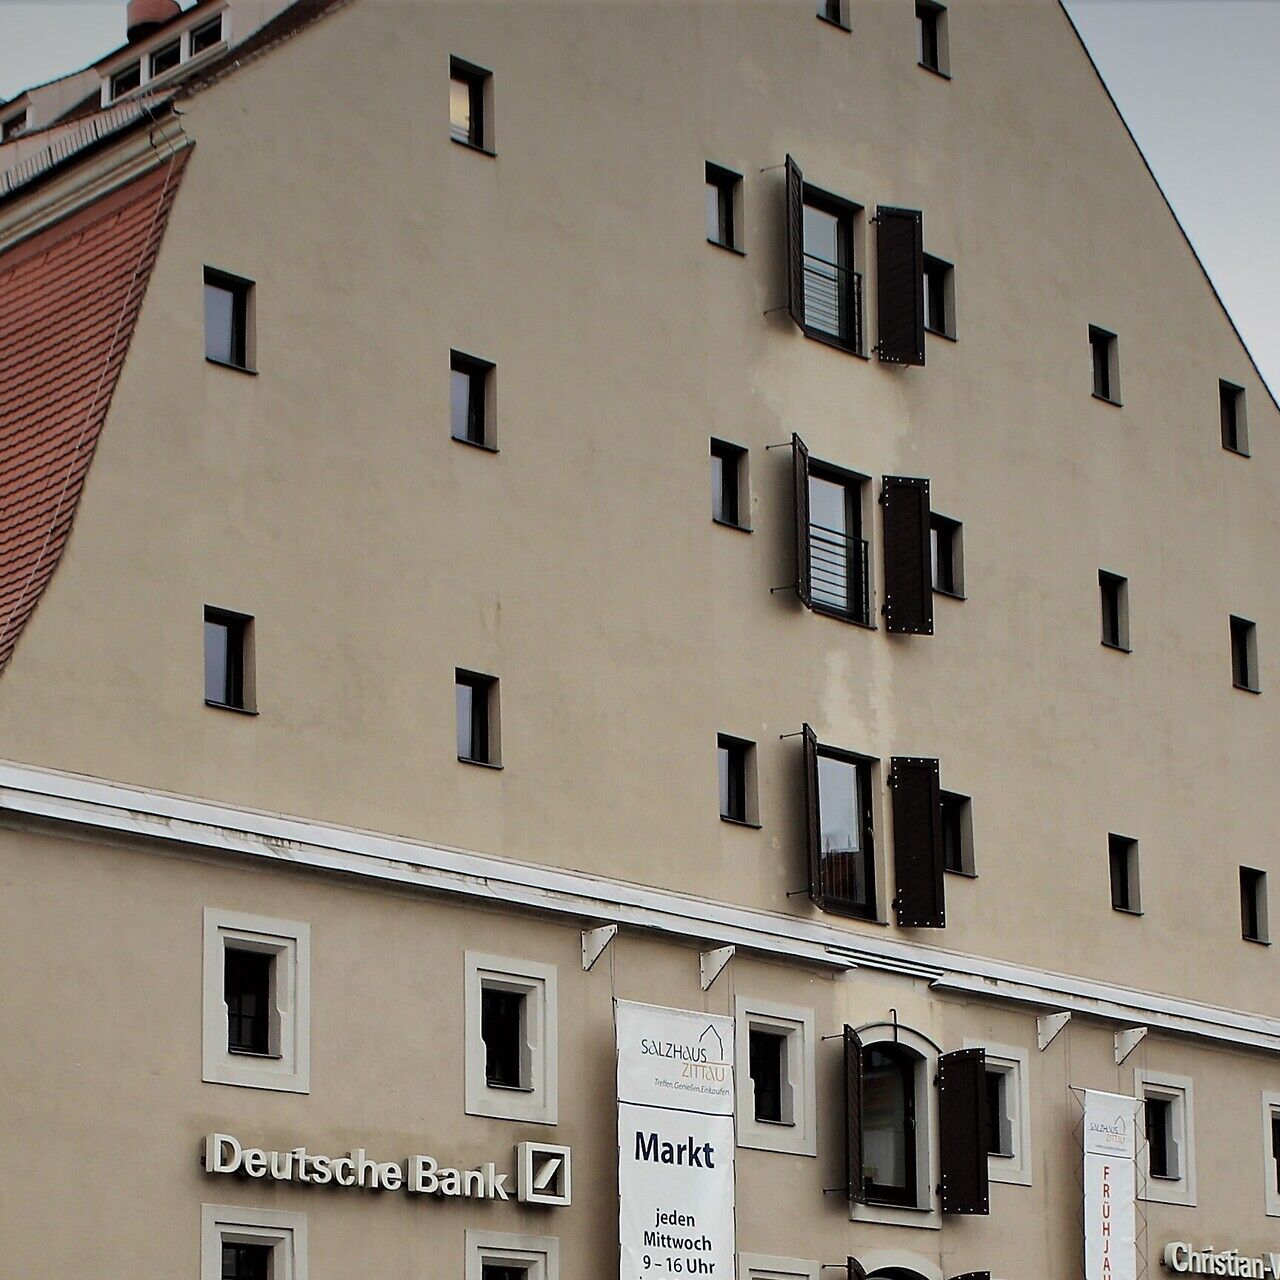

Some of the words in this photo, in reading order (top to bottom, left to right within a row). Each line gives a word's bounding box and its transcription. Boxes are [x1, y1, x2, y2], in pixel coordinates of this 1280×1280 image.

[640, 1038, 708, 1064] SALZHAUS
[682, 1063, 725, 1082] ZITTAU
[634, 1131, 715, 1169] Markt
[206, 1133, 403, 1191] Deutsche
[407, 1155, 510, 1201] Bank
[655, 1207, 696, 1228] jeden
[643, 1230, 712, 1252] Mittwoch
[642, 1254, 652, 1270] 9
[665, 1257, 683, 1273] 16
[686, 1258, 716, 1275] Uhr
